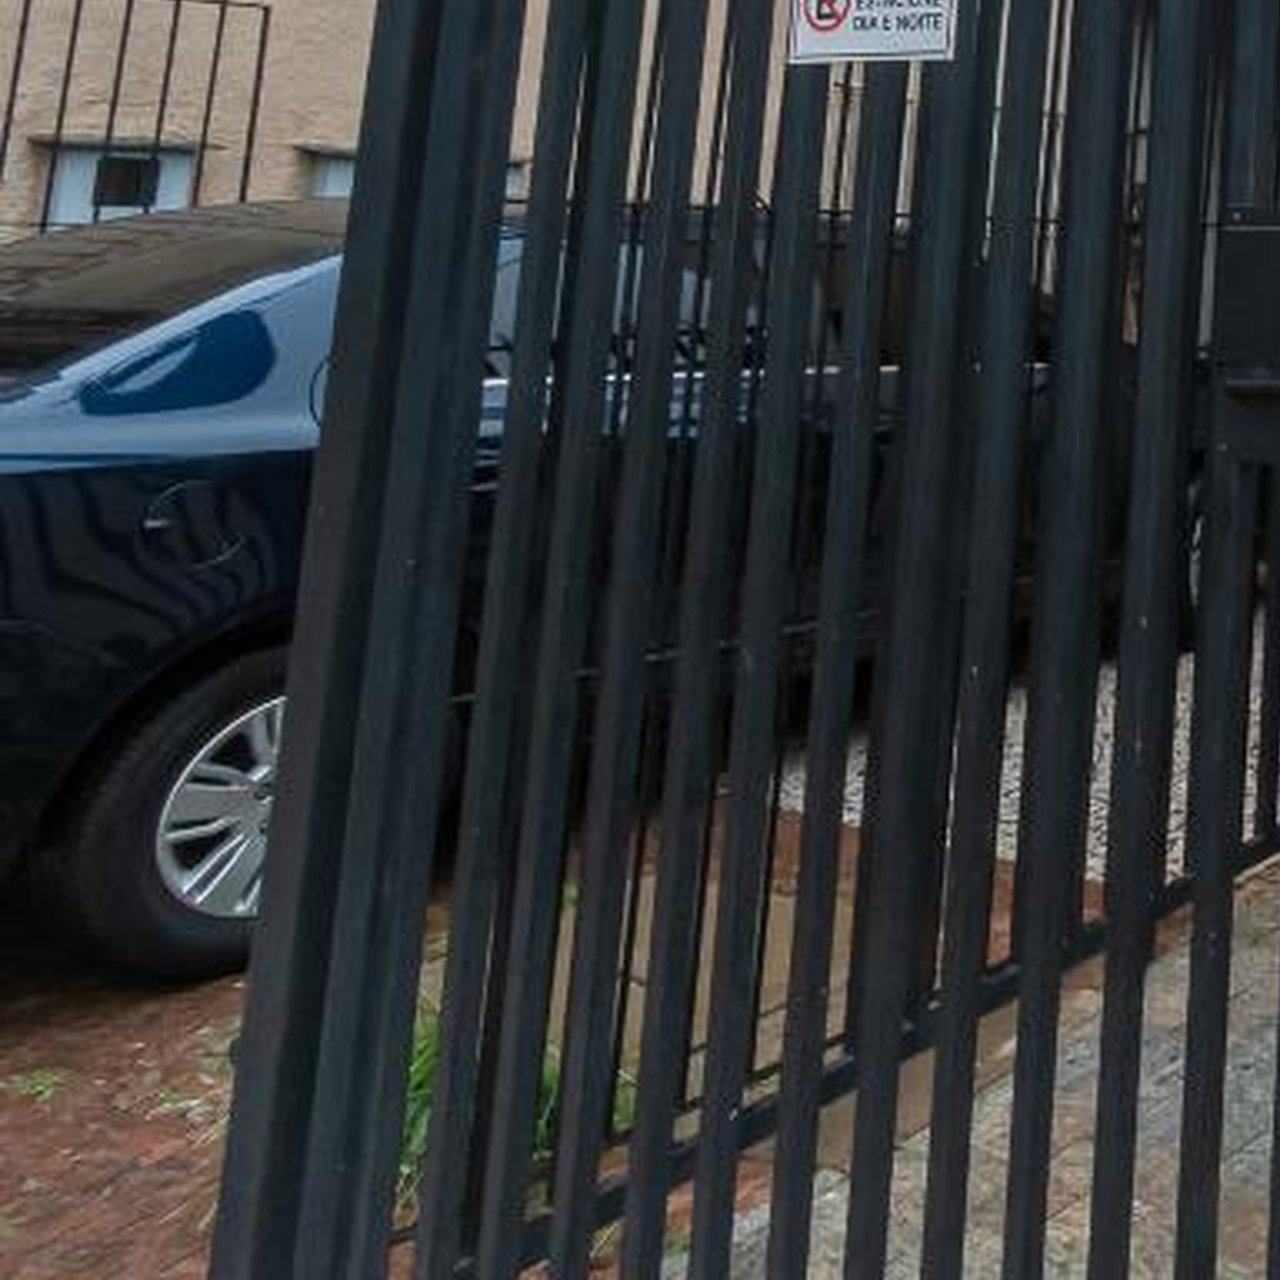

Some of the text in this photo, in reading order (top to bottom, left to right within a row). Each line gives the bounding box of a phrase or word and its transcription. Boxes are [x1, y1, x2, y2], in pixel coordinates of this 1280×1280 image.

[853, 12, 944, 31] DIA E NOITE
